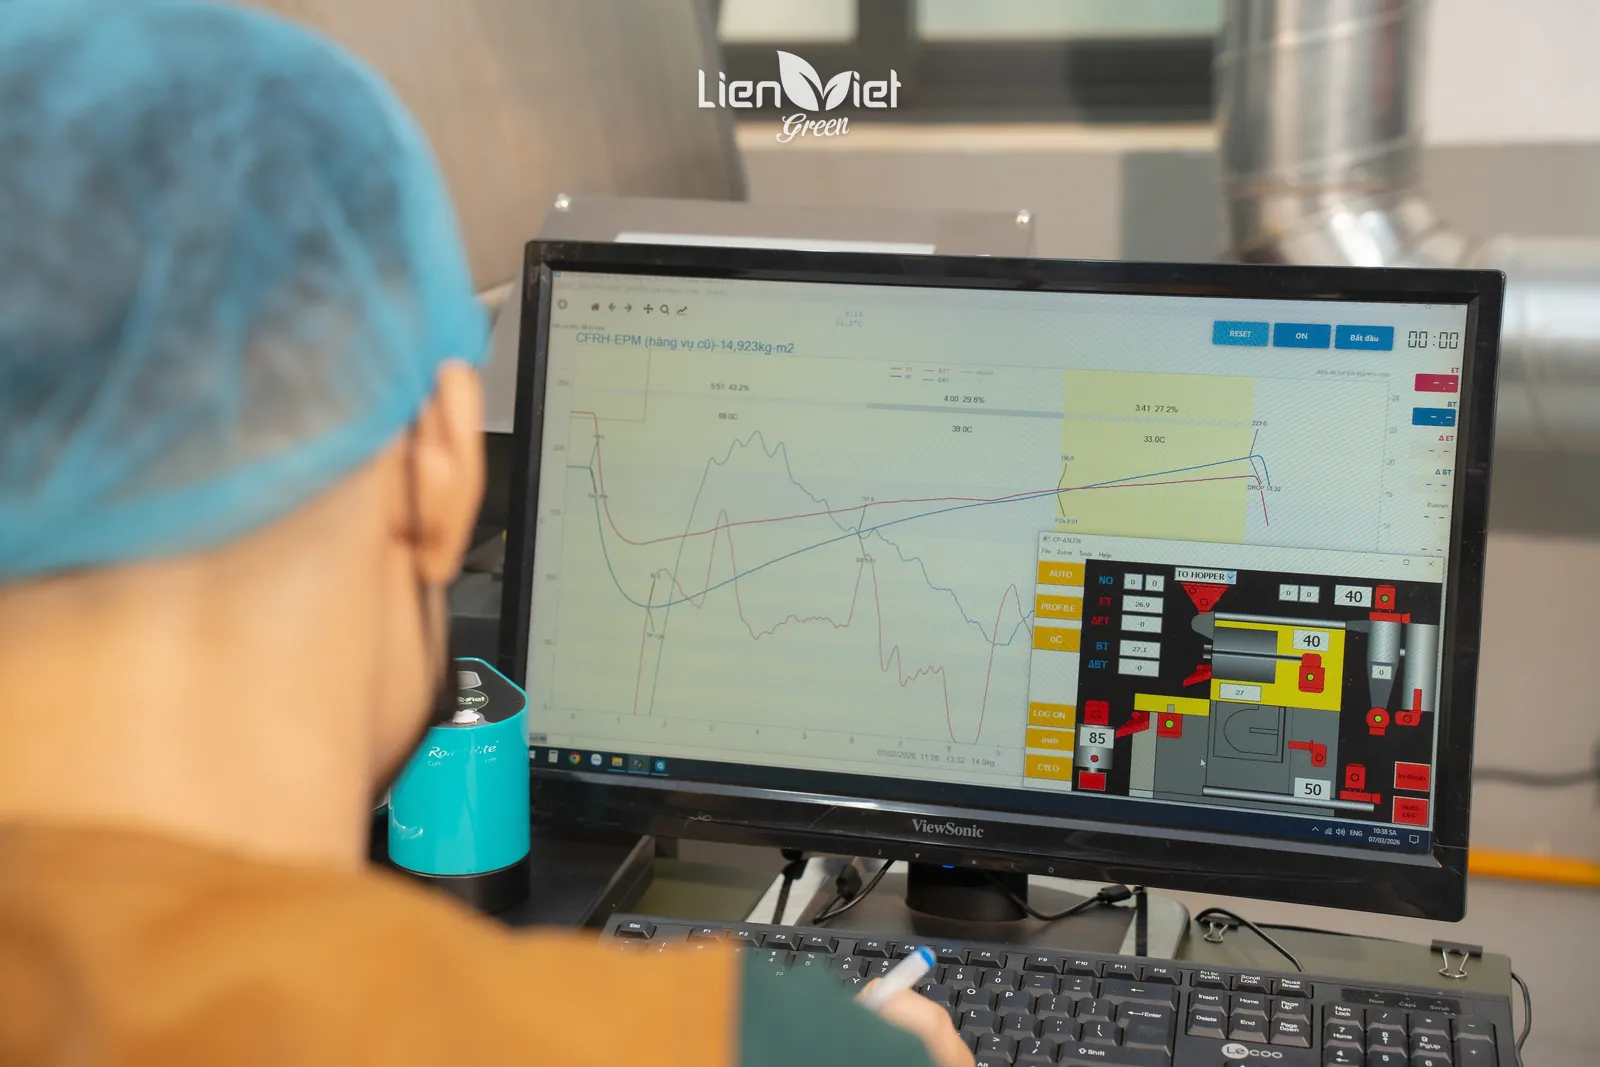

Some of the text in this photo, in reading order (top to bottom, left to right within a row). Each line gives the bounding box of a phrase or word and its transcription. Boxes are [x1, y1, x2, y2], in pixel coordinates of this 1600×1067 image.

[1229, 330, 1251, 338] RESET
[1295, 332, 1308, 340] ON
[576, 332, 795, 356] CFRH-EPM (hàng vụ cũ)-14,923kg-m2
[1408, 331, 1458, 349] 00:00
[1154, 405, 1179, 414] 27.2%
[1144, 435, 1166, 444] 33.0C
[1056, 549, 1073, 557] Zoom
[1079, 550, 1093, 558] Tools
[1049, 571, 1073, 579] AUTO
[1178, 570, 1225, 581] TO HOPPER
[1099, 576, 1113, 584] NO
[1152, 580, 1158, 588] 0
[1286, 589, 1311, 599] 0 0
[1344, 590, 1363, 603] 40
[1098, 598, 1111, 606] ET
[1041, 603, 1075, 613] PROFILE
[1091, 617, 1110, 625] ΔET
[1303, 635, 1321, 648] 40
[1096, 643, 1109, 651] BT
[1088, 660, 1107, 668] ΔBT
[1235, 688, 1244, 696] 27
[1033, 709, 1066, 719] LOG ON
[1089, 733, 1105, 745] 85
[1305, 783, 1322, 796] 50
[912, 818, 985, 839] ViewSonic
[1373, 827, 1388, 836] 10:38
[1368, 836, 1401, 846] 07/03/2026
[1198, 993, 1219, 1001] Insert
[1239, 997, 1259, 1005] Home
[1280, 1000, 1298, 1008] Page
[1399, 1001, 1417, 1009] Caps
[1144, 1011, 1162, 1019] Enter
[1196, 1015, 1218, 1023] Delete
[1240, 1019, 1256, 1027] End
[1333, 1033, 1352, 1041] Home
[1419, 1043, 1441, 1051] PgUp
[1087, 1048, 1106, 1056] Shift
